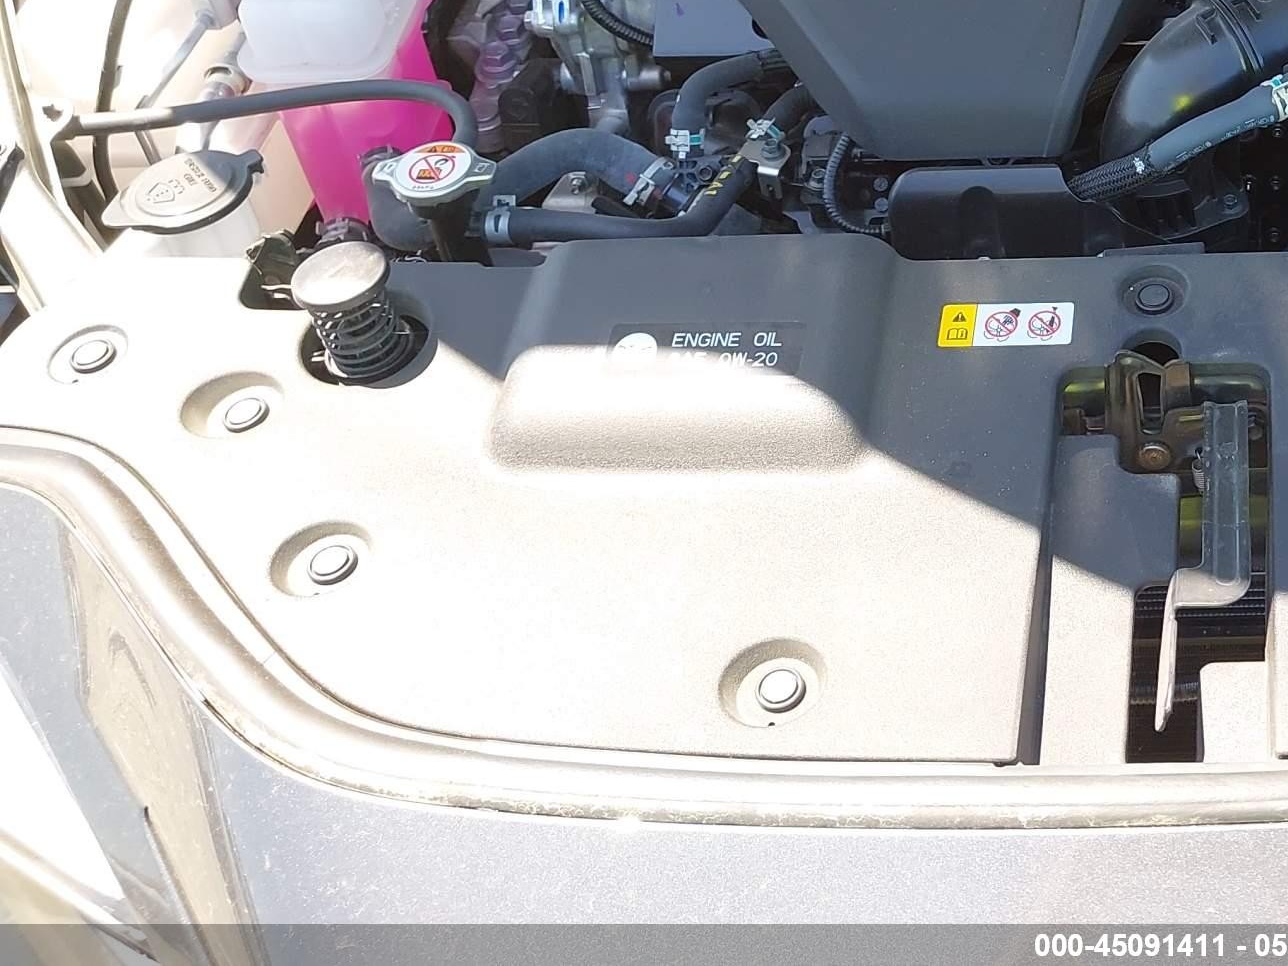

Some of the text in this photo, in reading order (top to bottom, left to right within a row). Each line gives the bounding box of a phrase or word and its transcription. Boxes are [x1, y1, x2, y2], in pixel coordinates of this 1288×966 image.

[671, 332, 782, 347] ENGINE OIL
[719, 351, 778, 367] 0W-20
